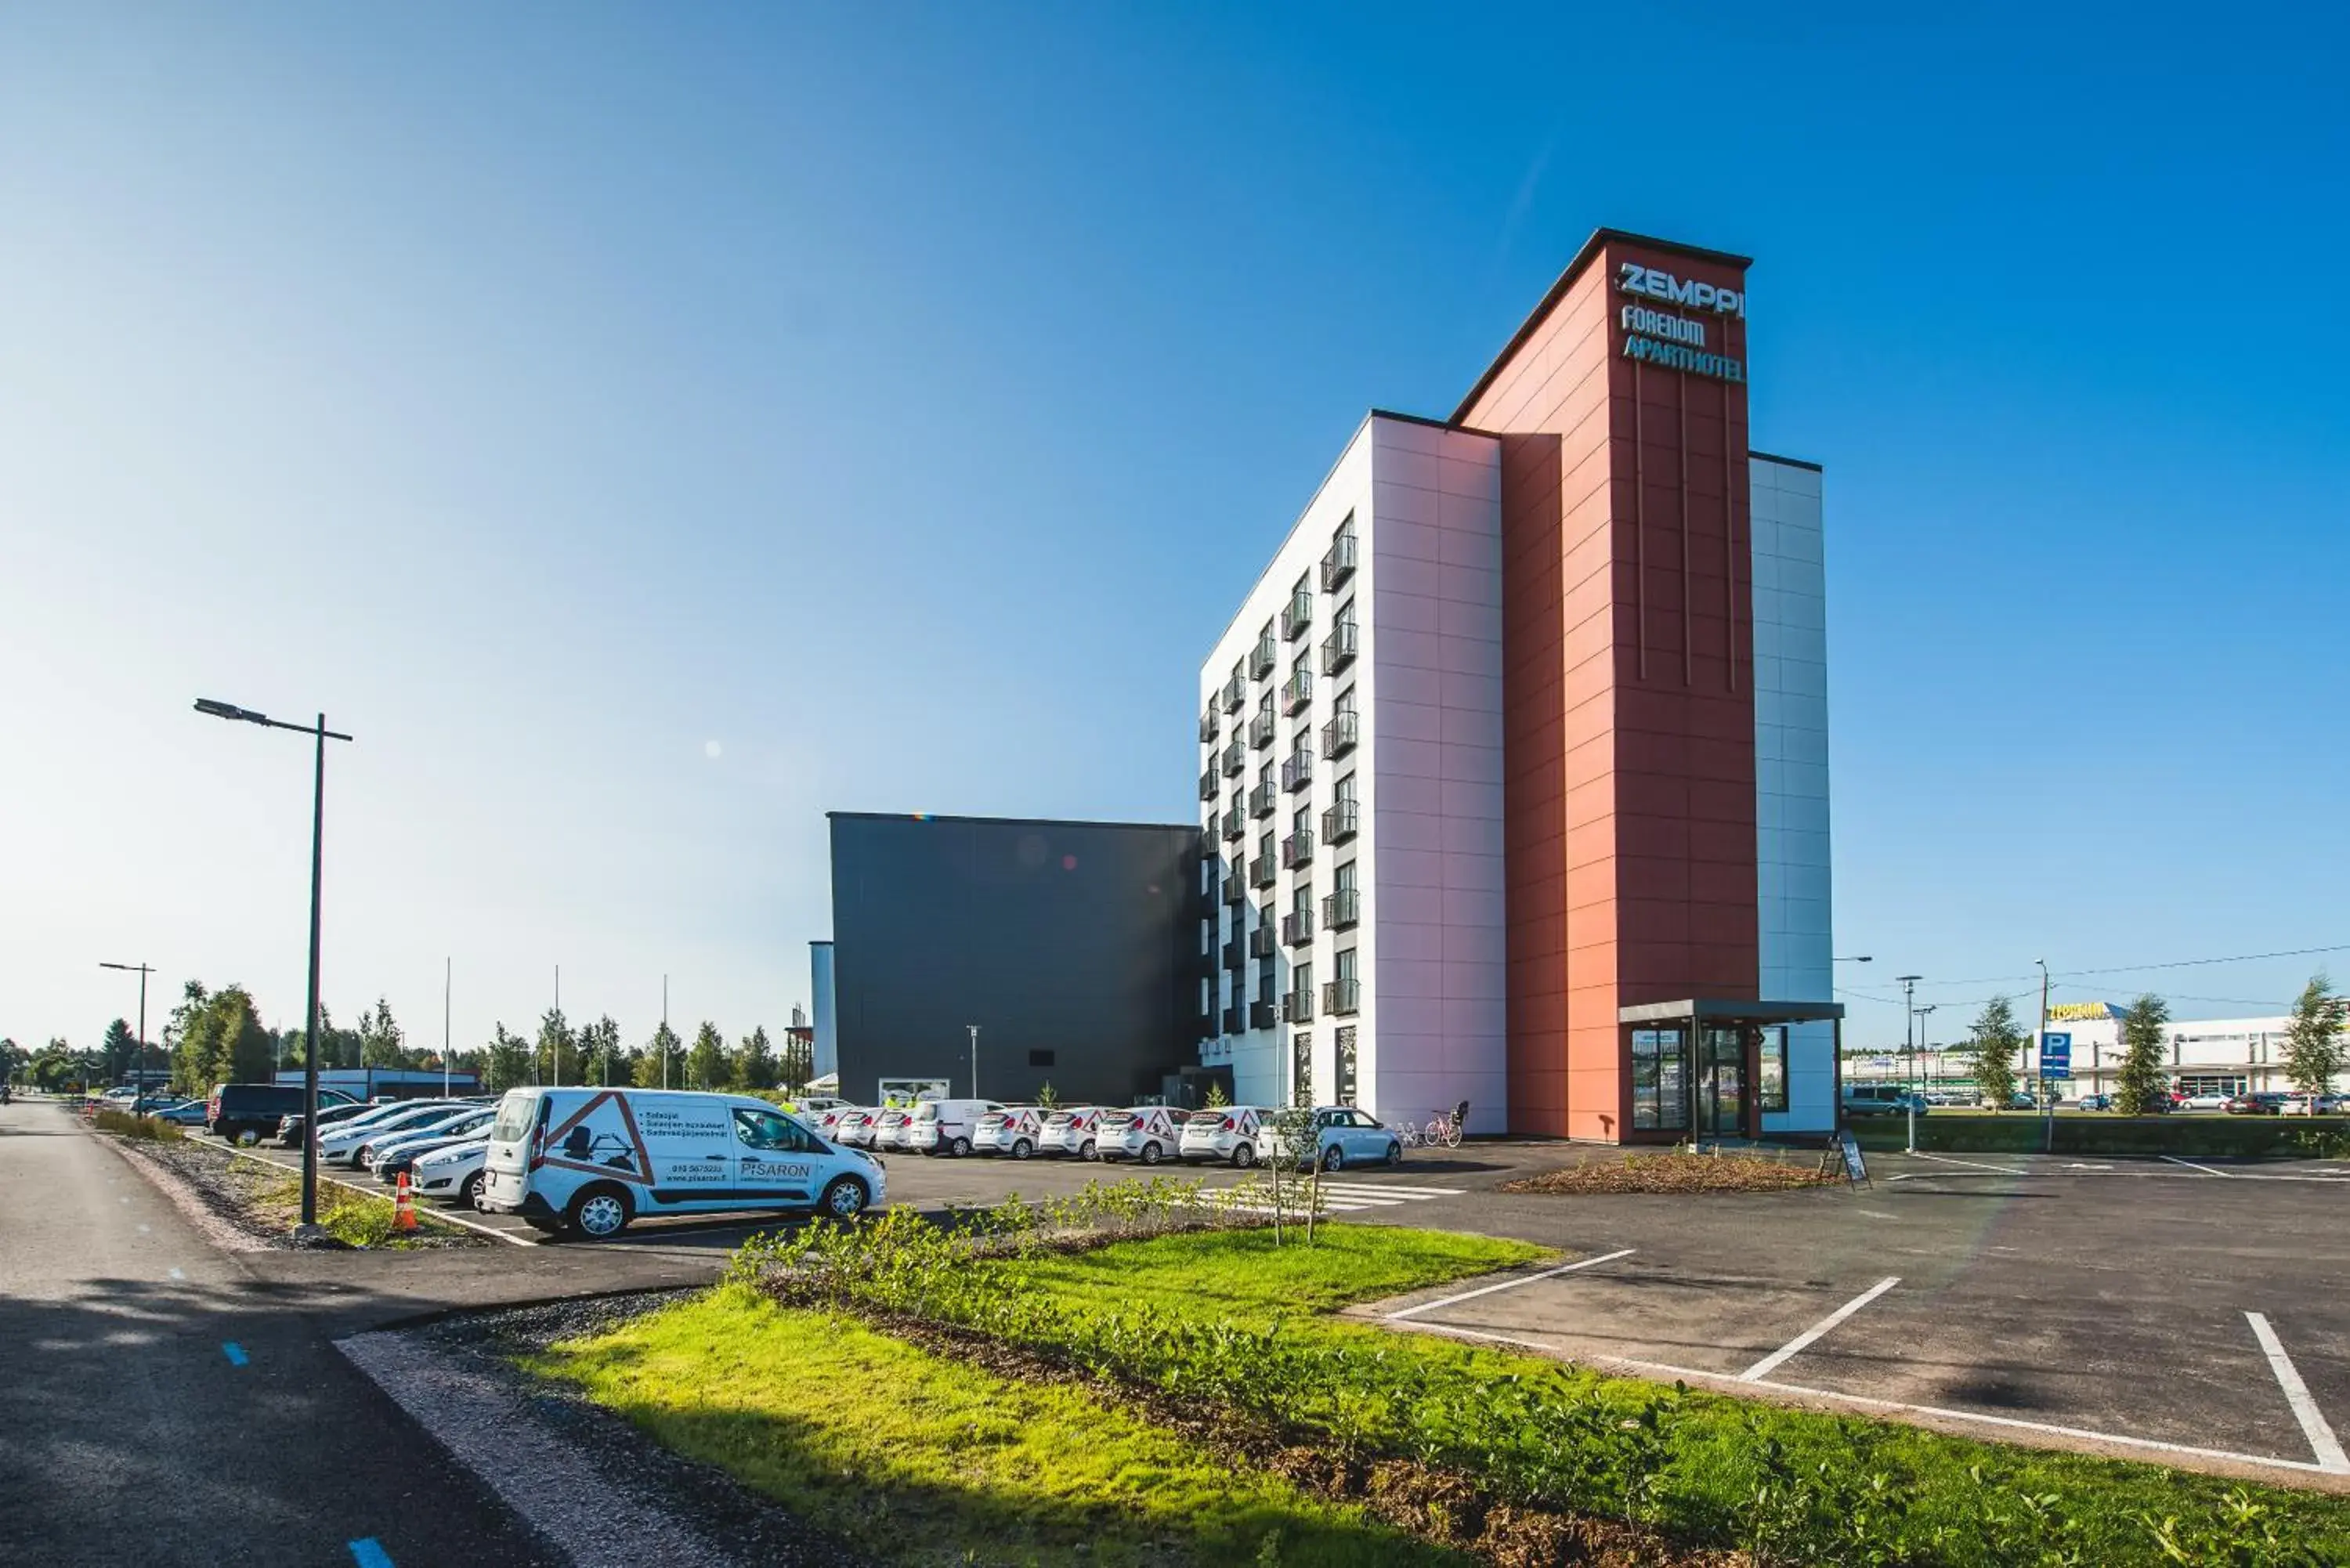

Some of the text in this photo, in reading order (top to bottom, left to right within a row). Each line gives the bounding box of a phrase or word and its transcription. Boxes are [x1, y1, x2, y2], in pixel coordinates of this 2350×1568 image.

[1621, 262, 1744, 320] ZEMPPI
[1623, 334, 1742, 381] APARTHOTEL
[2047, 1035, 2066, 1054] P
[740, 1163, 809, 1176] PISARON
